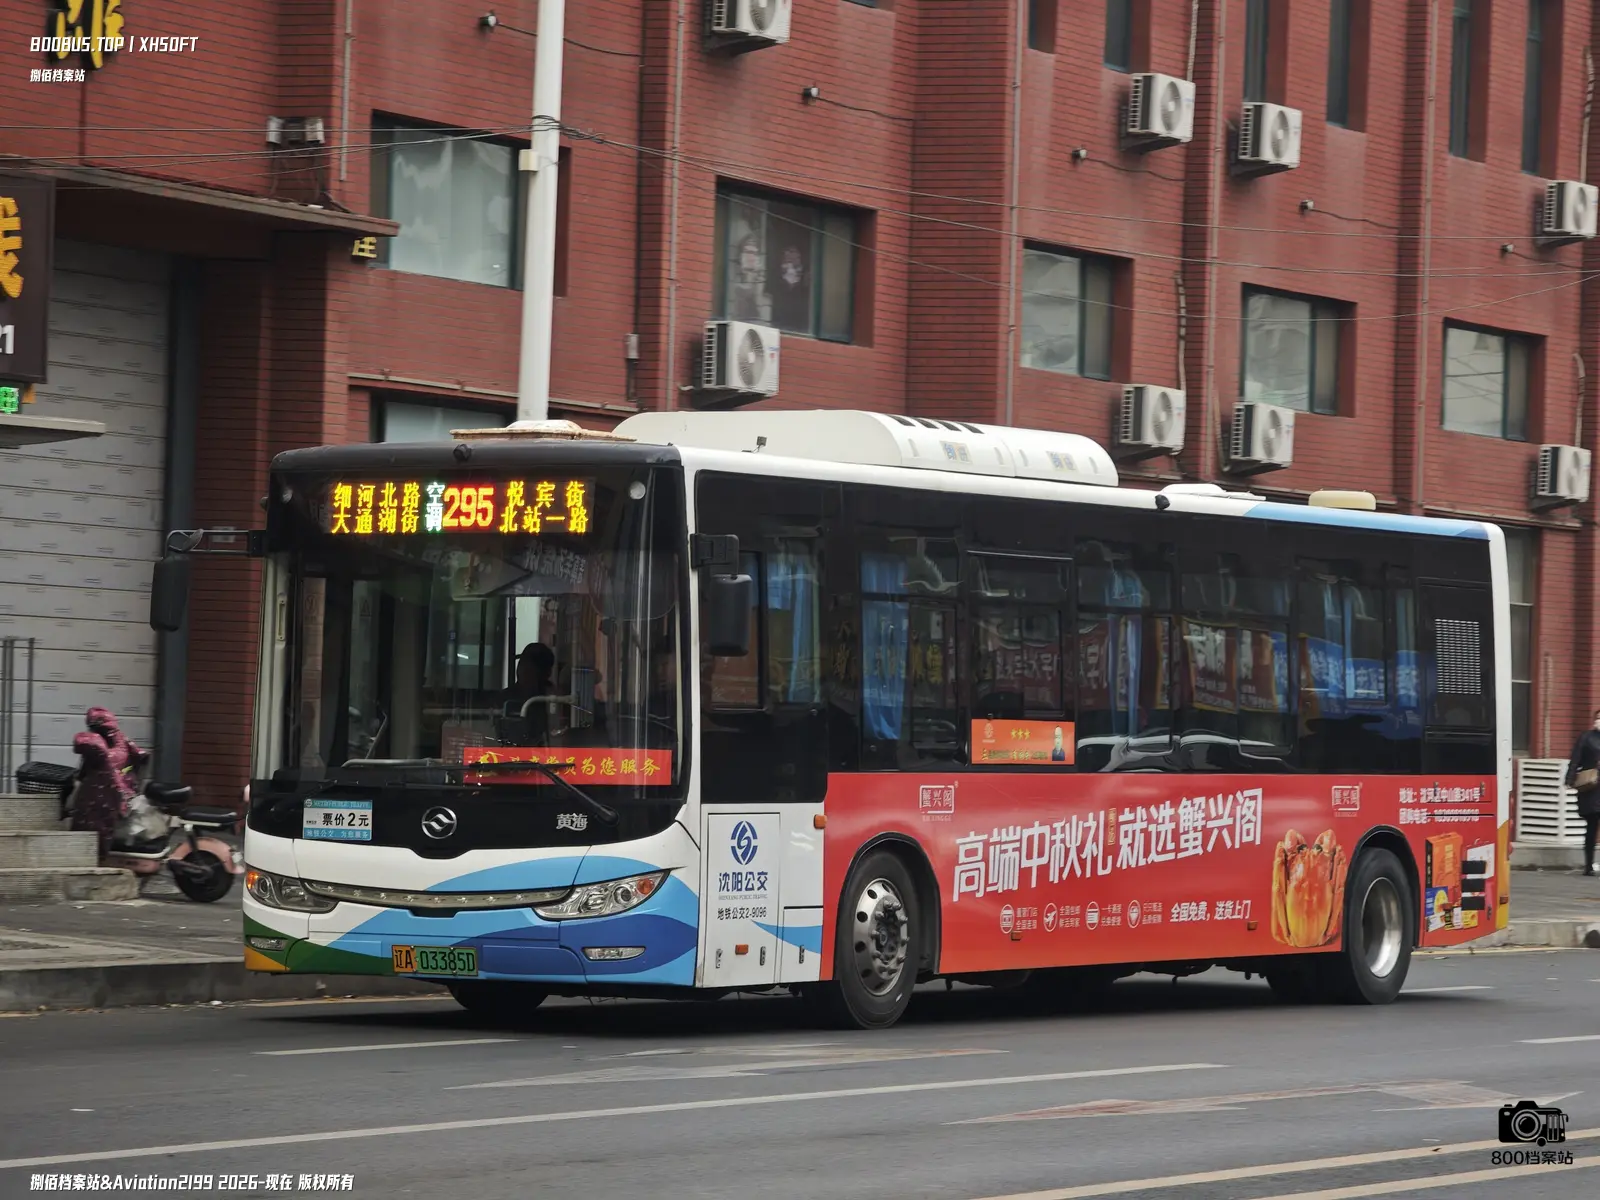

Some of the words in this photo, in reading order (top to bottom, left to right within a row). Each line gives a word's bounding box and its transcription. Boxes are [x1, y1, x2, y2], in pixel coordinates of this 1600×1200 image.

[333, 482, 420, 508] 细河北路
[443, 487, 494, 528] 295
[331, 507, 420, 534] 大通湖街
[499, 506, 589, 534] 北站一路
[323, 812, 369, 827] 票价2元
[556, 813, 588, 831] 黄海
[952, 810, 1112, 902] 高端中秋礼
[1116, 788, 1262, 869] 就选蟹兴阁
[718, 871, 768, 892] 沈阳公交
[717, 907, 767, 920] 地铁公交2-9096
